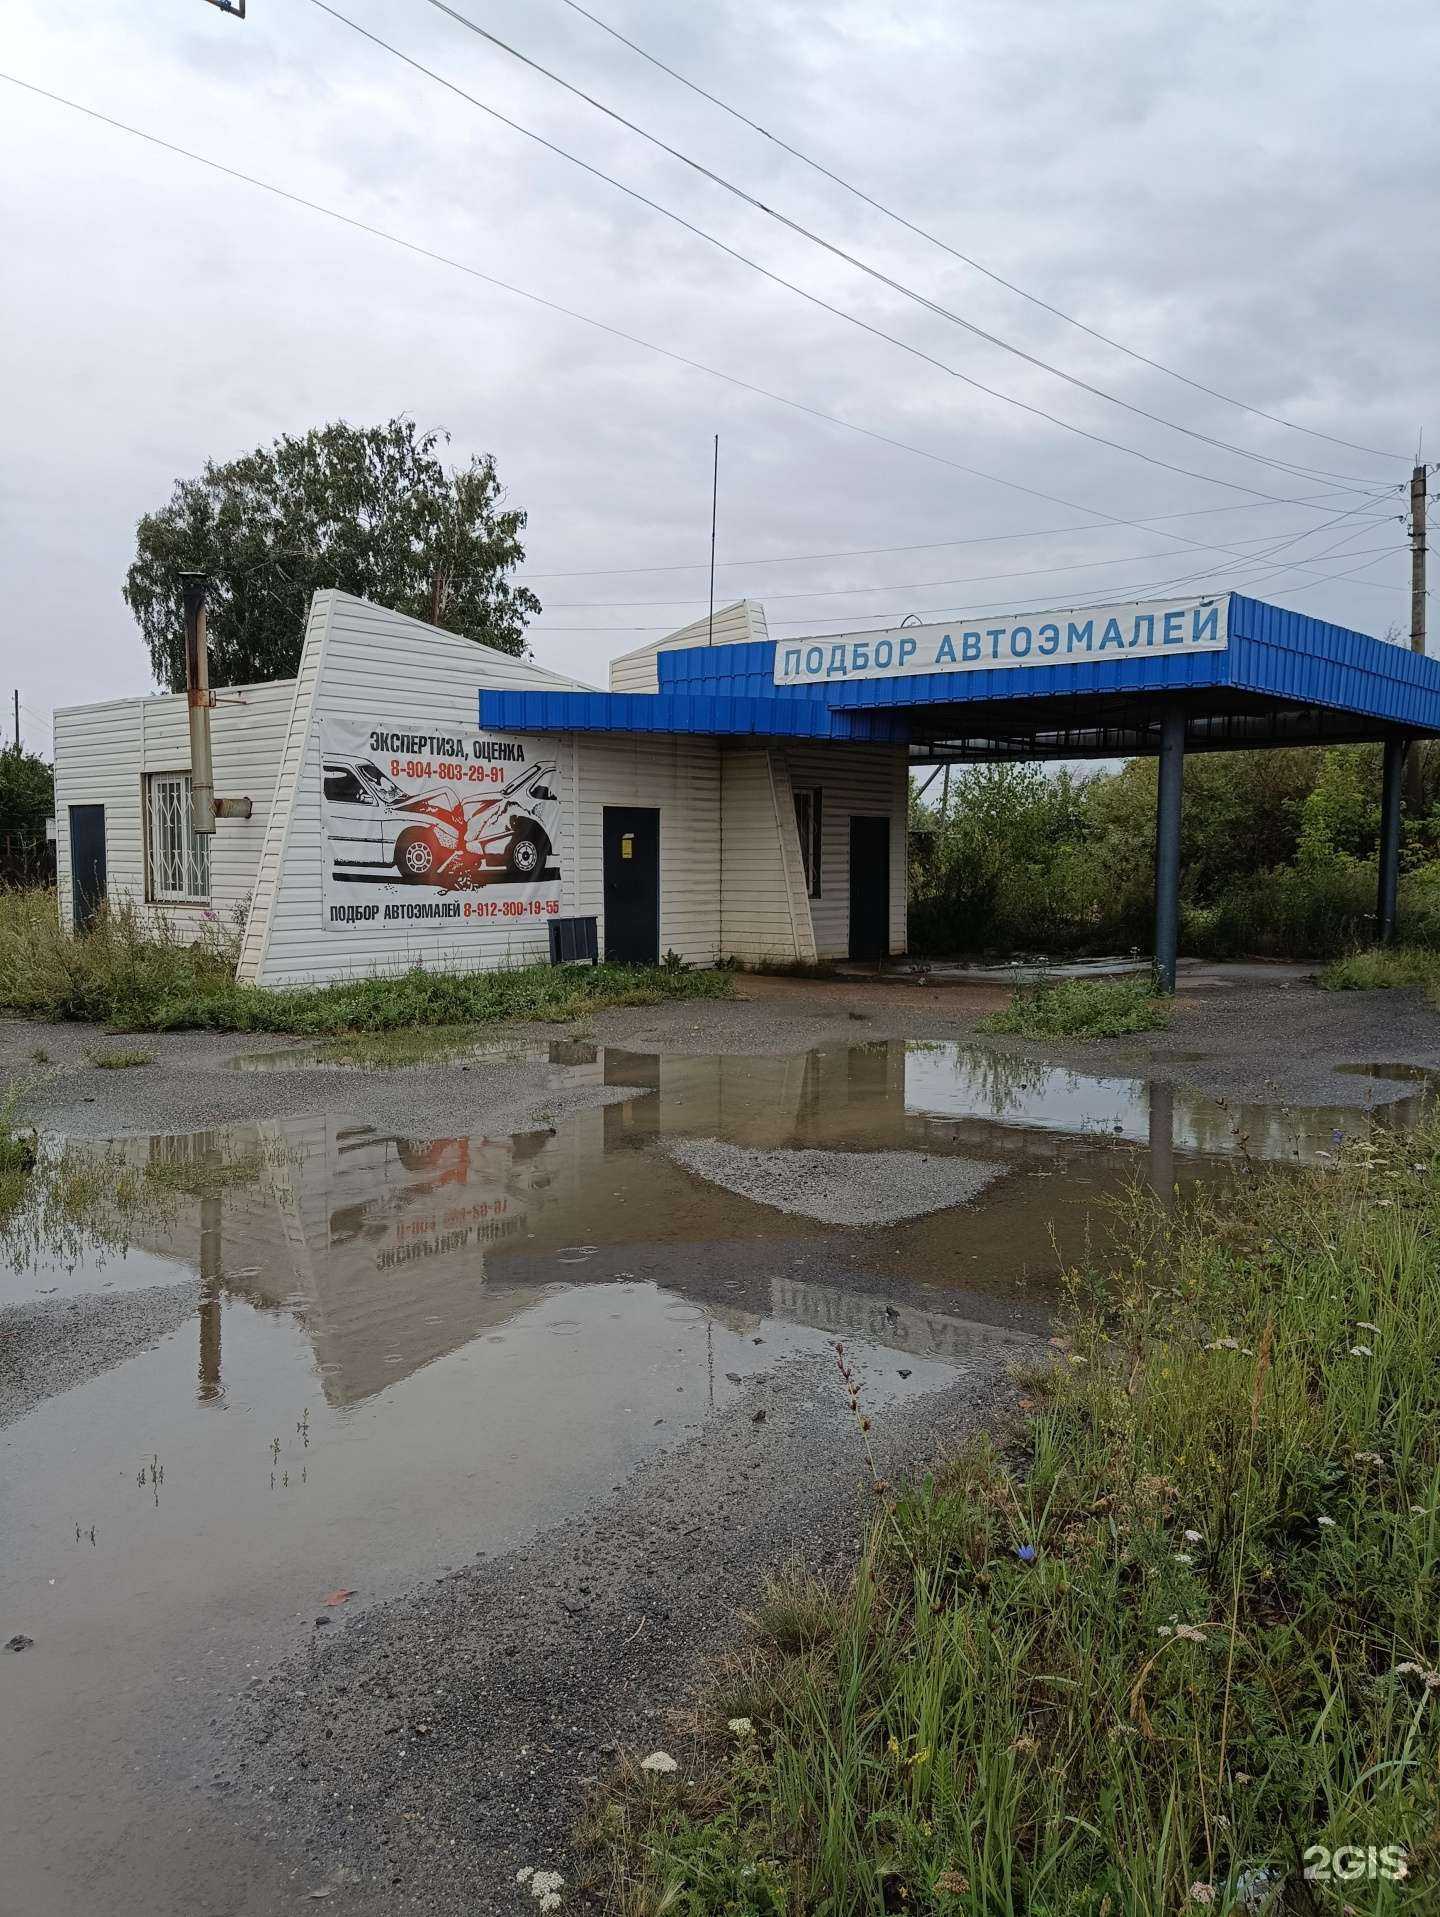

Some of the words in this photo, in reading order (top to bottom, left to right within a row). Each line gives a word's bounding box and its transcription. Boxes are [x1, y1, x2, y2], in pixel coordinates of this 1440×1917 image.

[783, 638, 918, 678] ПОДБОР
[935, 600, 1219, 664] АВТОЭМАЛЕЙ
[370, 731, 469, 761] ЭКСПЕРТИЗА,
[473, 740, 525, 762] ОЦЕНКА
[390, 759, 505, 783] 8-904-803-29-91
[330, 905, 380, 924] ПОДБОР
[384, 900, 461, 920] АВТОЭМАЛЕЙ
[463, 900, 560, 918] 8-912-300-19-55
